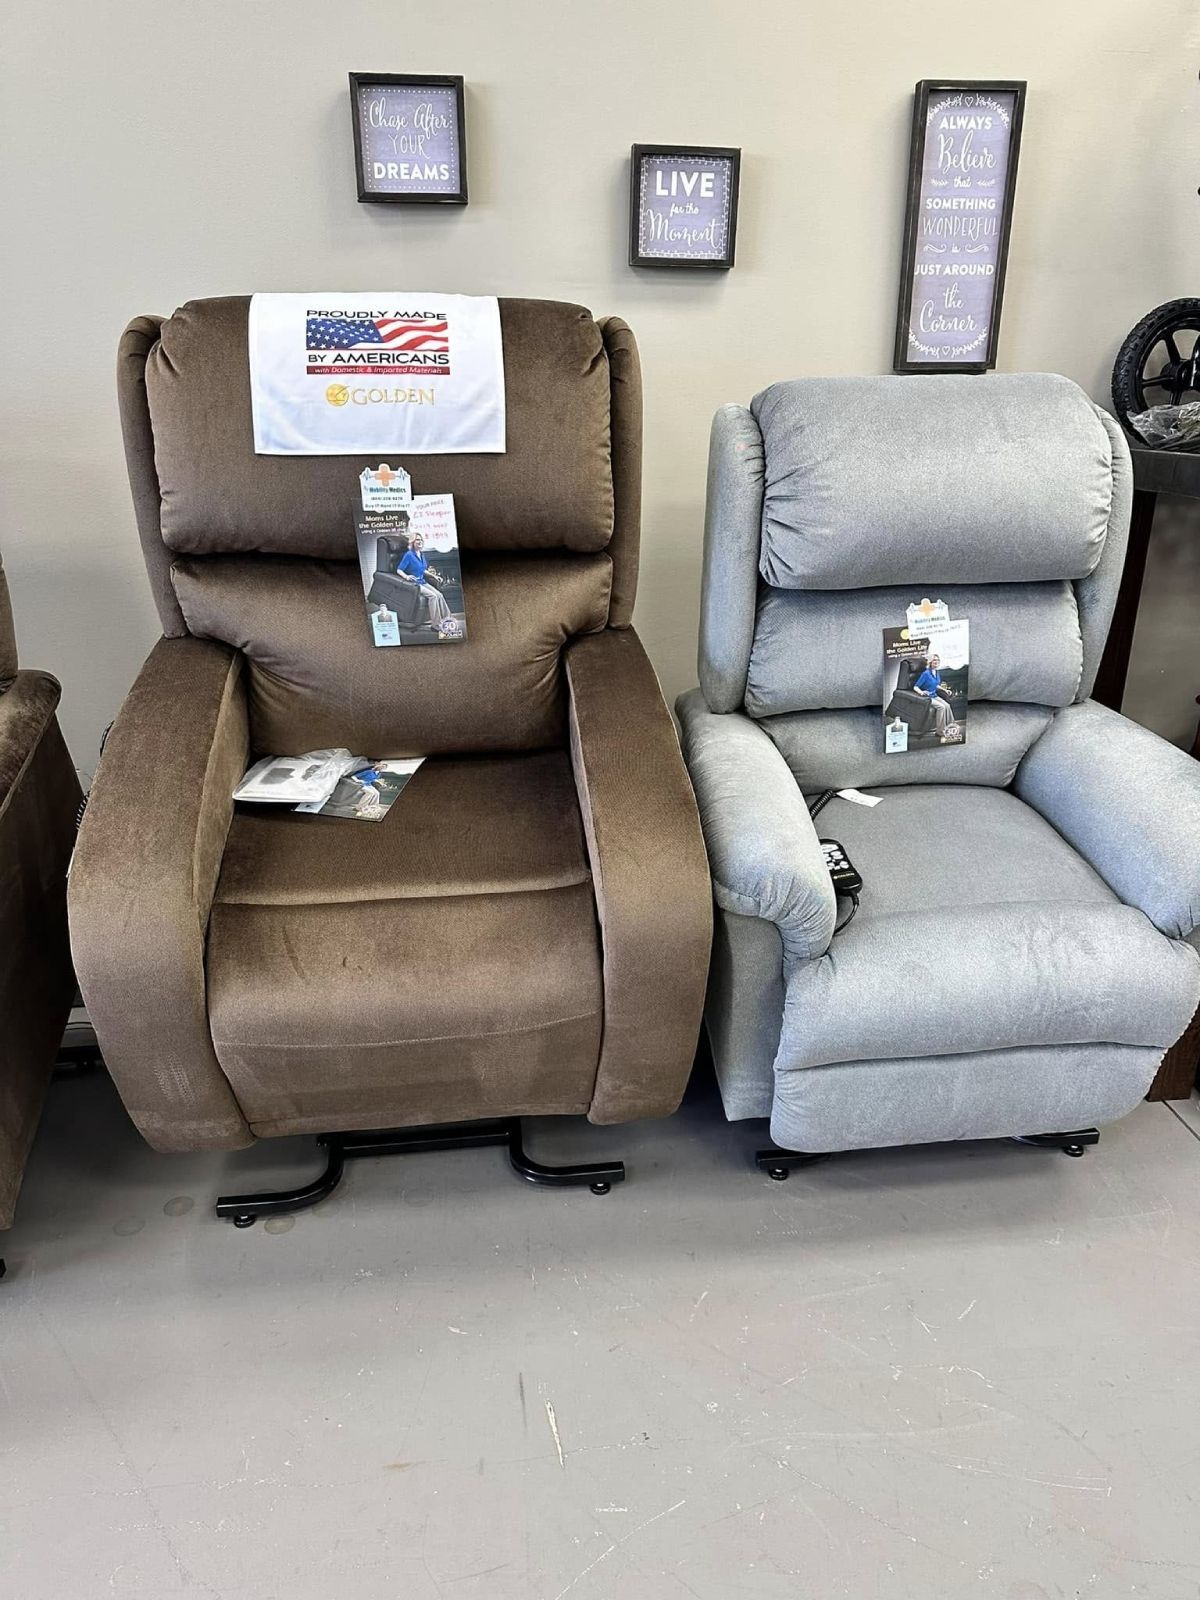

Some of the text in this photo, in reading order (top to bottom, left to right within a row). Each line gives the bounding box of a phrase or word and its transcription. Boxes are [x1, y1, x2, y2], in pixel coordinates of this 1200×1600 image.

[370, 97, 450, 140] Chase After
[939, 116, 993, 130] ALWAYS
[388, 134, 431, 159] YOUR
[938, 130, 996, 174] Believe
[373, 162, 450, 180] DREAMS
[655, 170, 715, 198] LIVE
[953, 176, 972, 188] that
[670, 203, 699, 218] for the
[925, 198, 996, 210] SOMETHING
[646, 208, 722, 249] Moment
[923, 216, 998, 241] WONDERFUL
[952, 243, 961, 253] is
[914, 264, 994, 276] JUST AROUND
[943, 282, 964, 309] the
[306, 310, 447, 320] PROUDLY MADE
[920, 300, 977, 333] Corner
[308, 353, 450, 364] BY AMERICANS
[352, 388, 436, 406] GOLDEN
